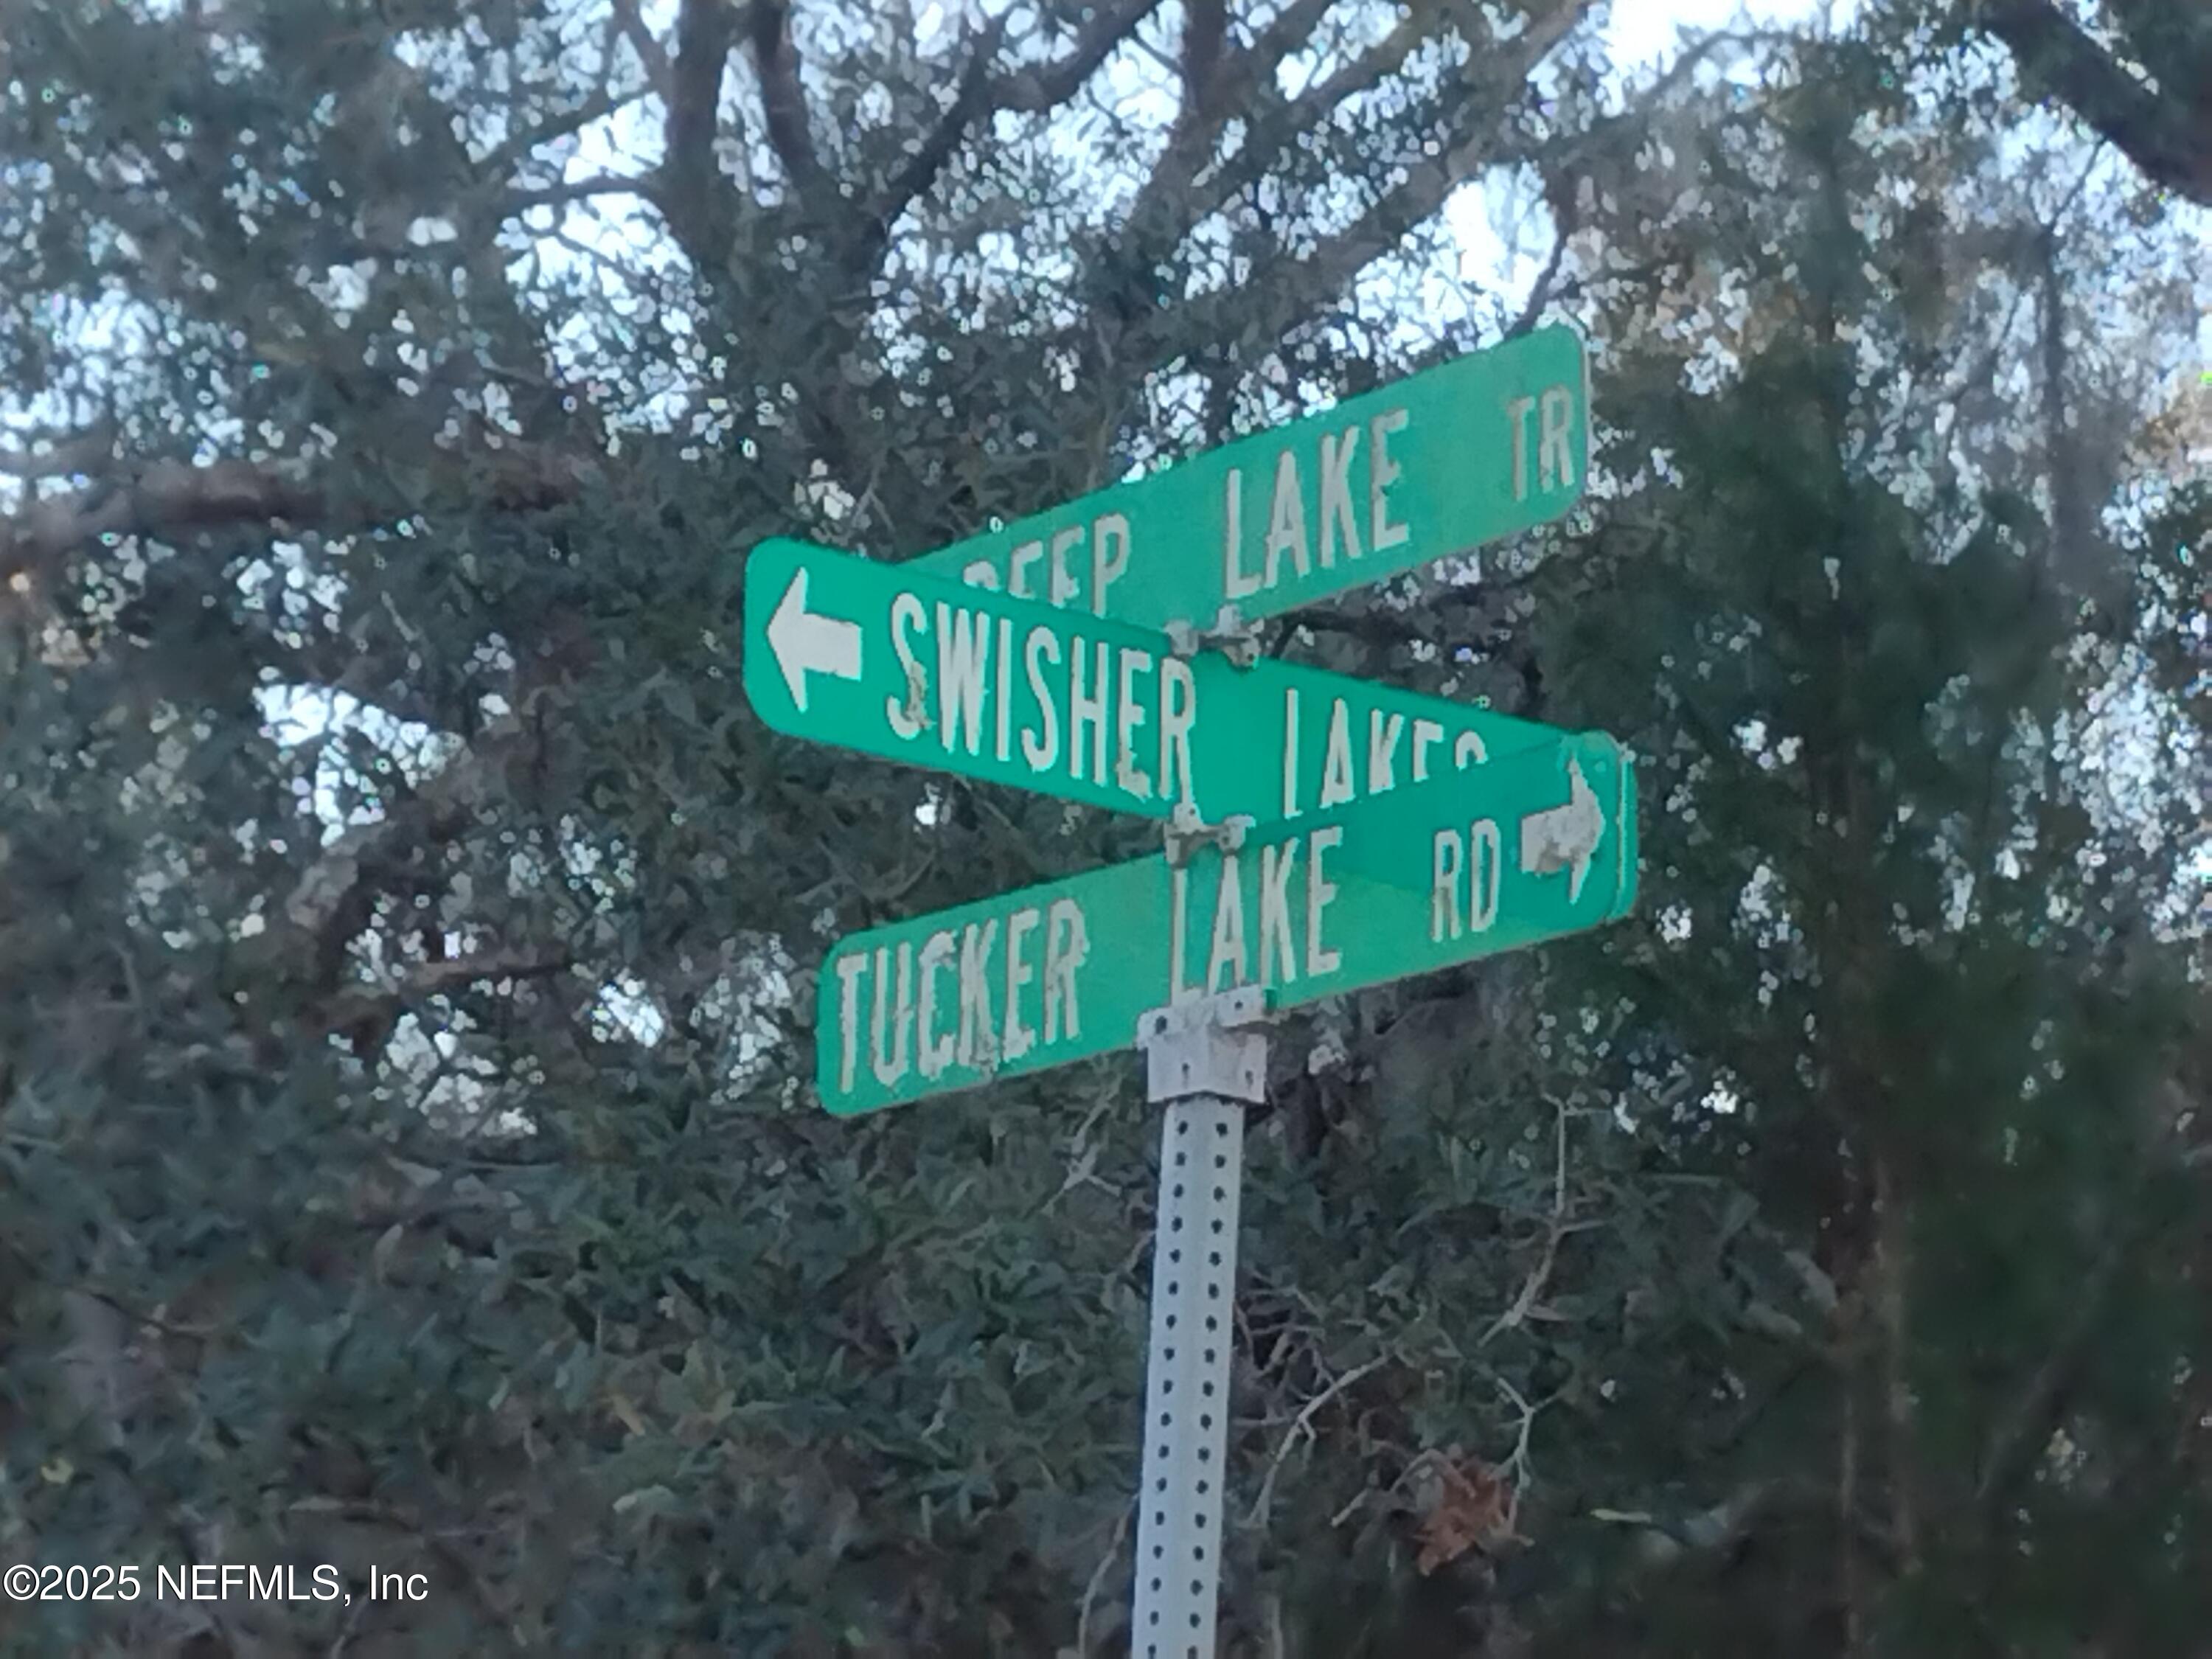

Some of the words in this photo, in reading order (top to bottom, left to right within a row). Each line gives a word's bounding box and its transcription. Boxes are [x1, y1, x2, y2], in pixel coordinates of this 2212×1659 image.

[963, 513, 1130, 619] EP
[1225, 408, 1411, 599] LAKE
[1506, 384, 1575, 501] TR
[887, 592, 1196, 805] SWISHER
[835, 899, 1088, 1093] TUCKER
[1171, 827, 1343, 1007] LAKE
[1430, 818, 1502, 943] RD
